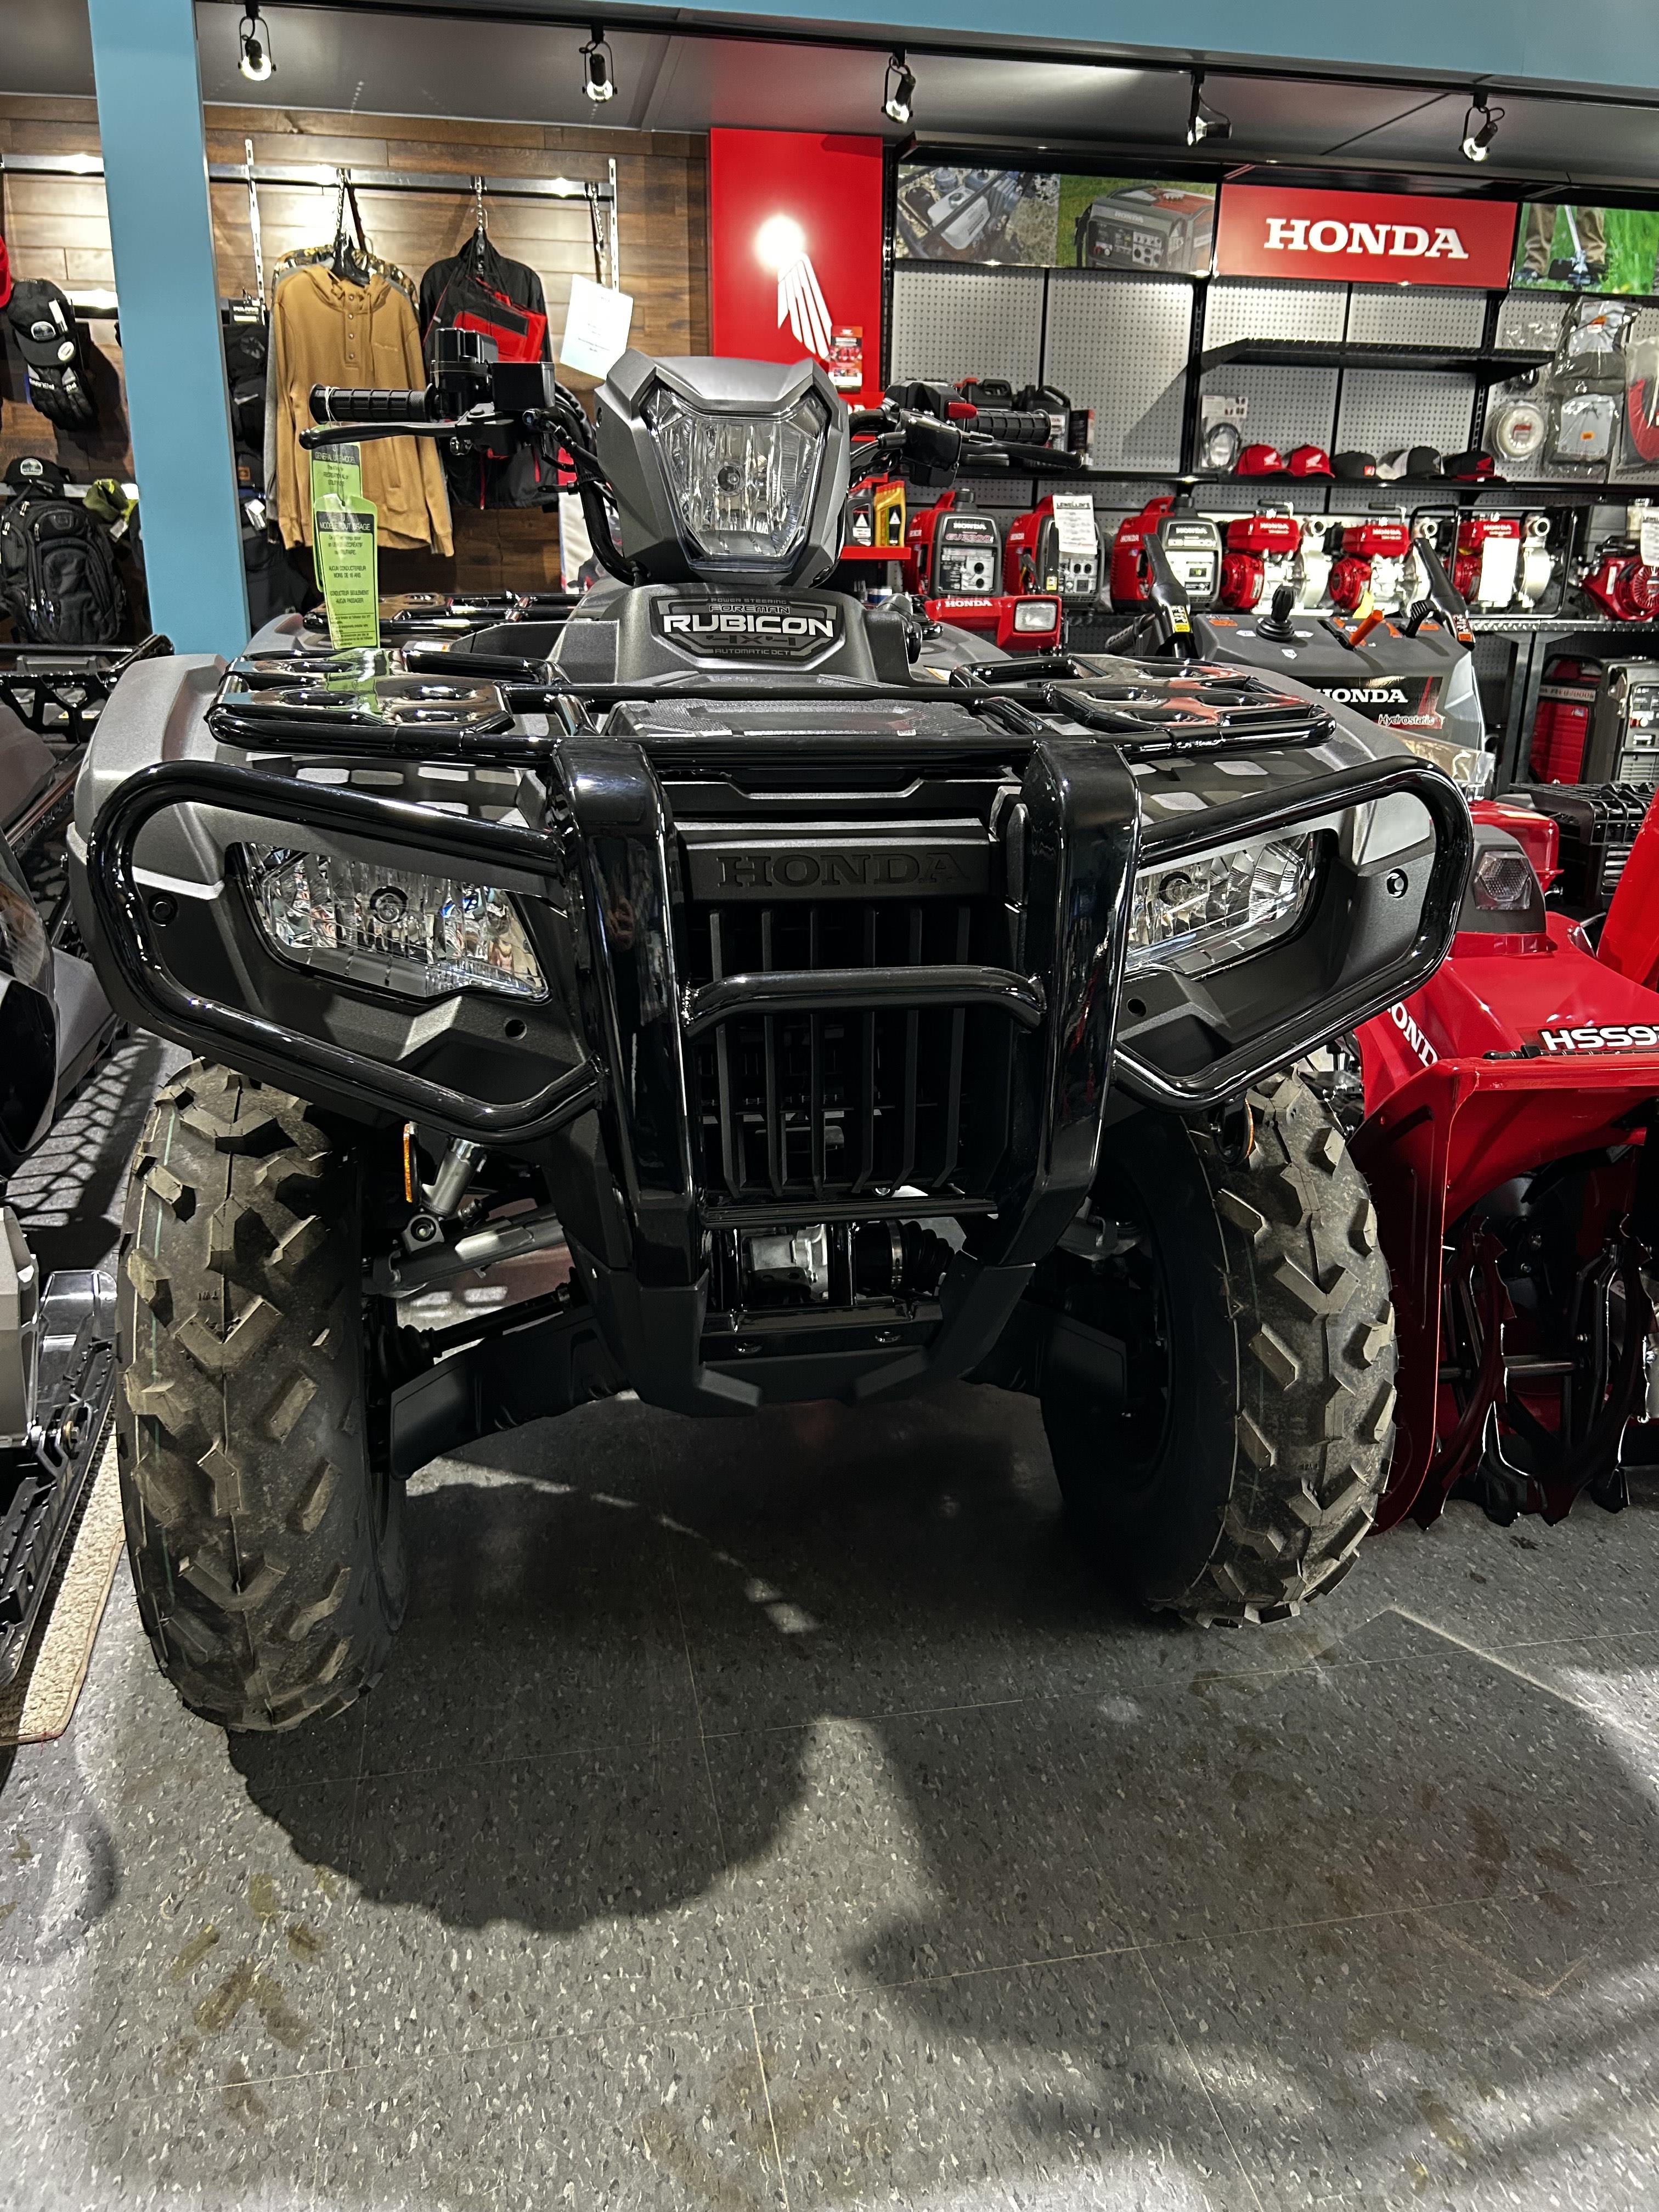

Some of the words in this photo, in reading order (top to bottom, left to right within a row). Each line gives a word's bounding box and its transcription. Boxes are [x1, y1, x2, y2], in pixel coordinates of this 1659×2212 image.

[1114, 211, 1144, 223] HONDA
[1264, 218, 1469, 259] HONDA
[709, 605, 790, 614] FOREMAN
[663, 614, 834, 637] RUBICON
[1378, 714, 1435, 726] Hydrostatic
[717, 852, 970, 888] HONDA
[1387, 1002, 1438, 1066] OND
